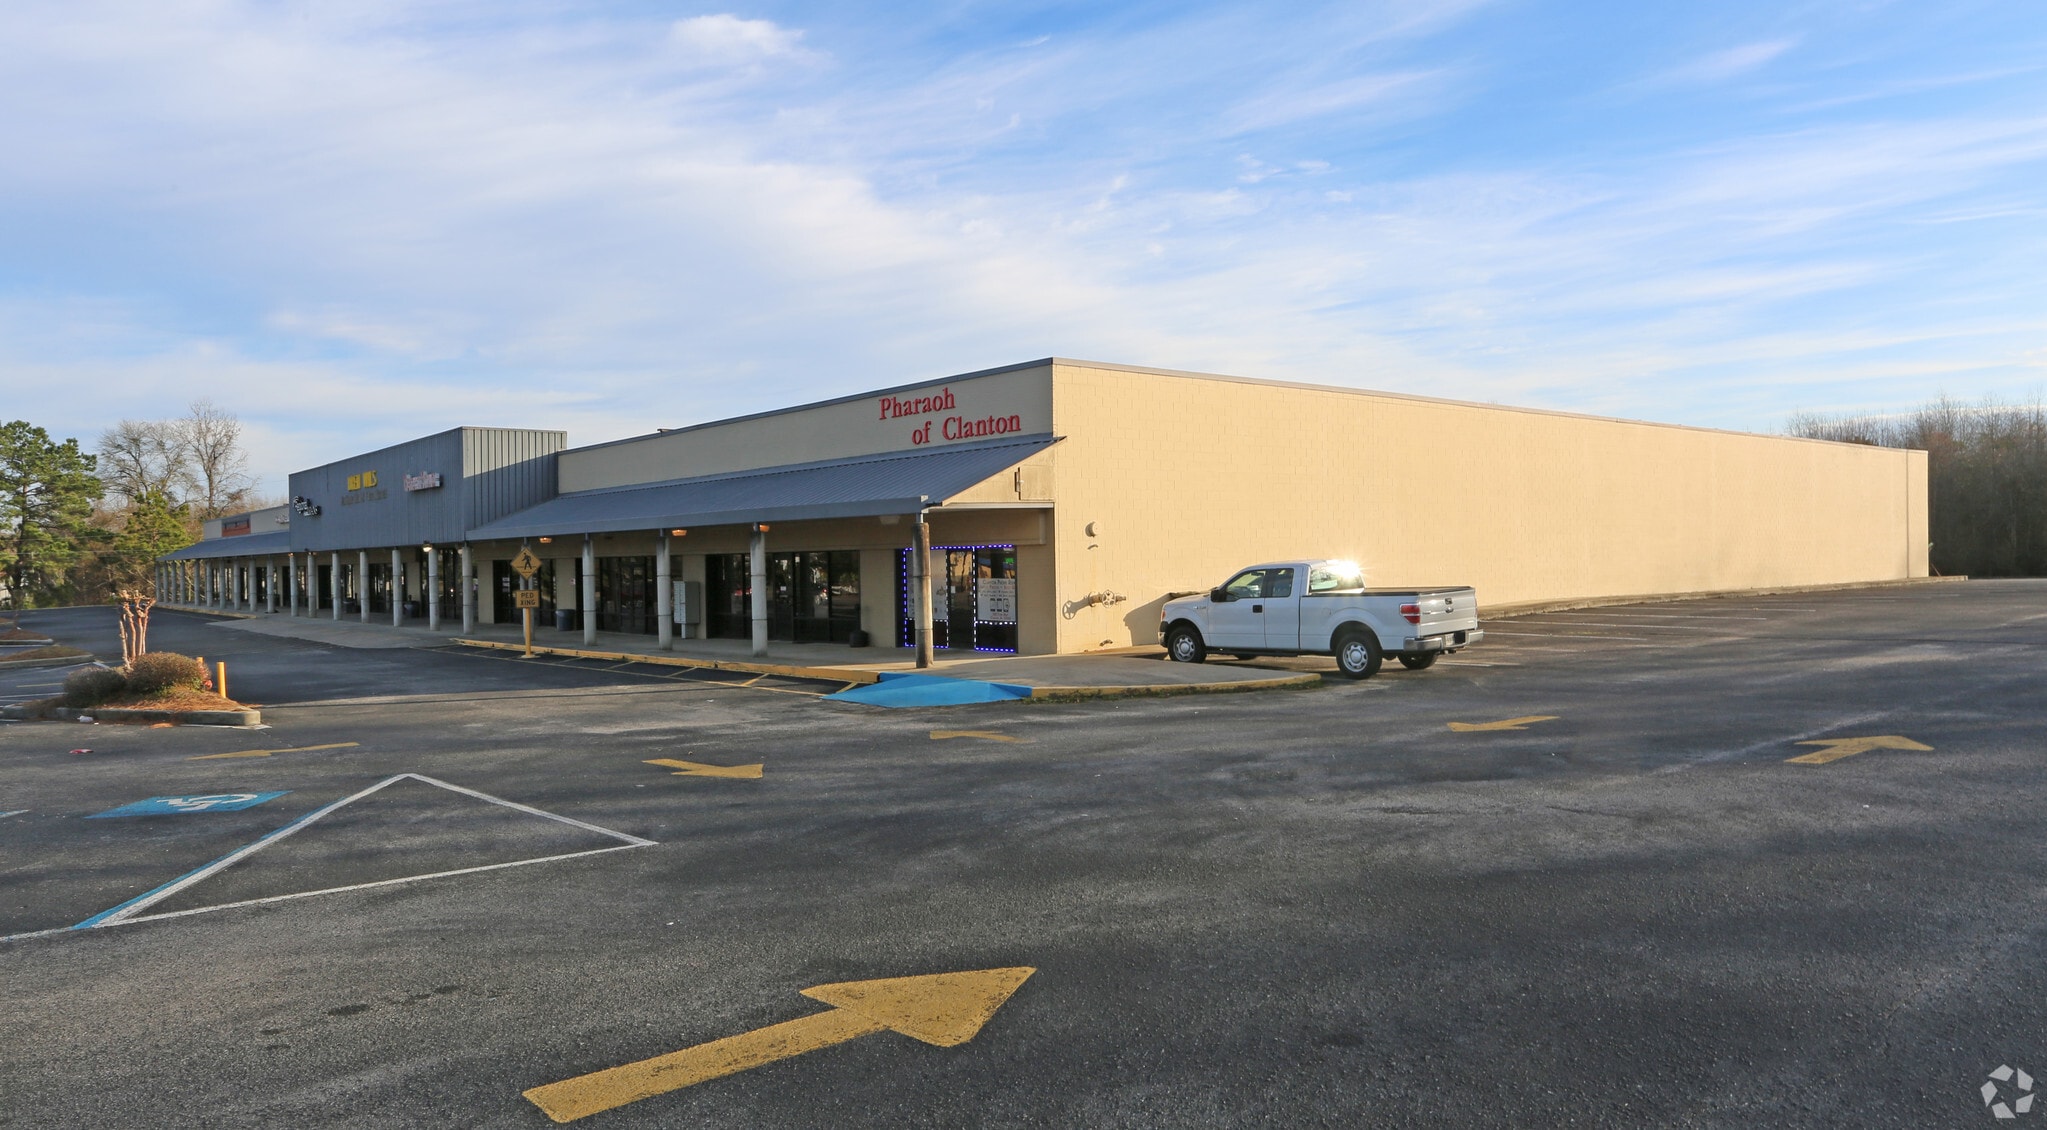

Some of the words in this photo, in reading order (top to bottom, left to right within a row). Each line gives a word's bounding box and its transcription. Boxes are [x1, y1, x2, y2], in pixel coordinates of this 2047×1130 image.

[878, 387, 956, 420] Pharaoh
[911, 421, 932, 445] of
[942, 414, 1022, 441] Clanton
